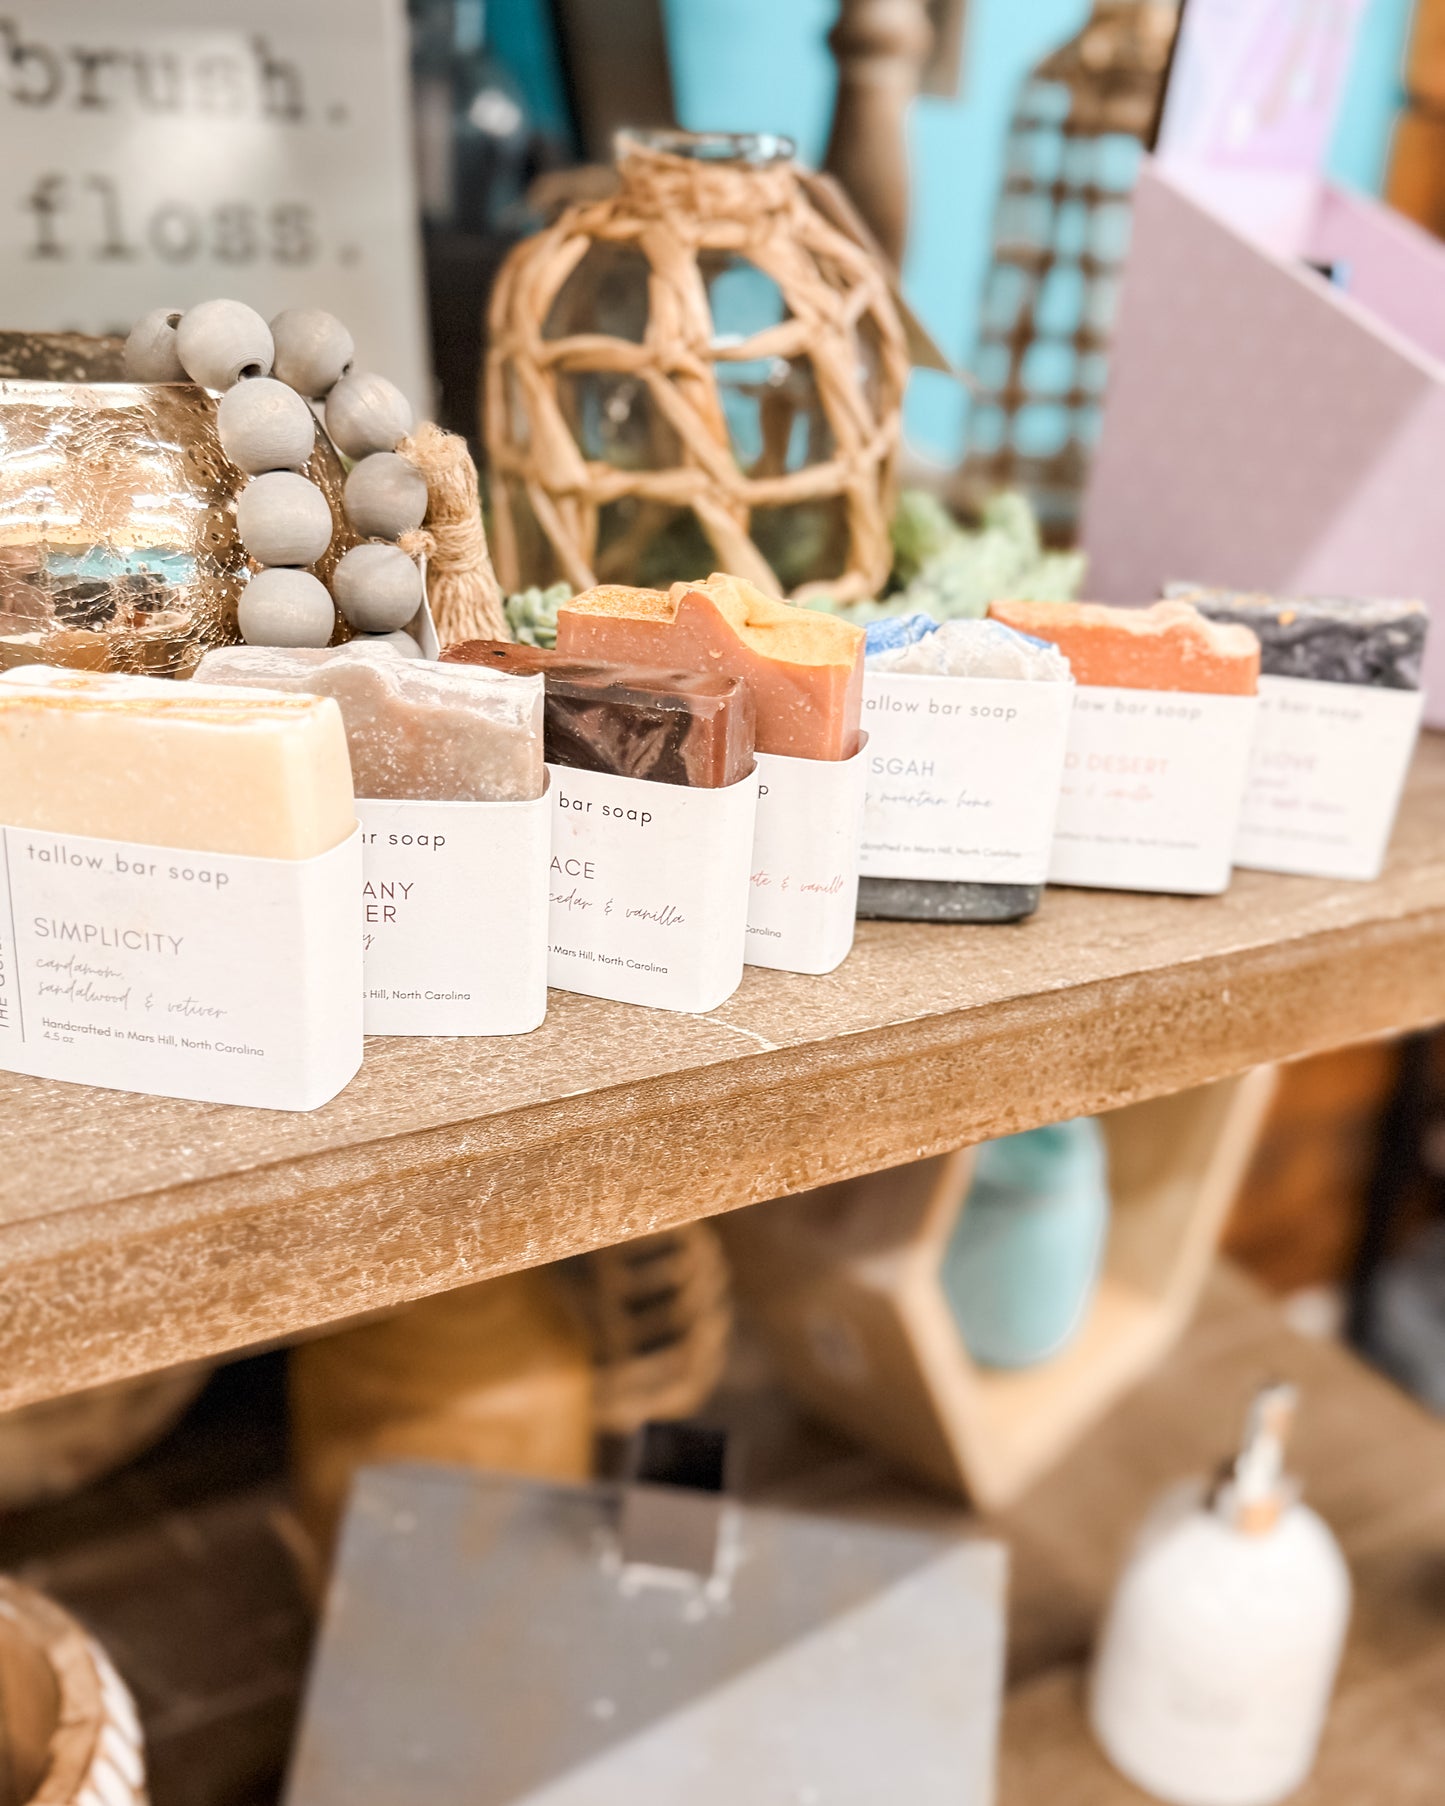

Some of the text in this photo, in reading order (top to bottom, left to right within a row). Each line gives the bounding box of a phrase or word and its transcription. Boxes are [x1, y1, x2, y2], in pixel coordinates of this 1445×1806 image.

[0, 15, 352, 126] brush.
[23, 173, 360, 266] floss.
[861, 694, 1018, 723] allow bar soap
[1114, 699, 1147, 715] bar
[1155, 705, 1203, 723] soap
[871, 757, 935, 777] SGAH
[1087, 752, 1169, 775] DESERT
[559, 791, 652, 827] bar soap
[388, 834, 446, 851] soap
[27, 844, 229, 890] tallow bar soap
[550, 856, 596, 880] ACE
[363, 881, 414, 900] ANY
[366, 904, 397, 923] ER
[604, 898, 614, 916] &
[626, 905, 686, 926] vanilla
[34, 917, 184, 955] SIMPLICITY
[553, 945, 577, 957] Mars
[578, 950, 596, 962] Hill,
[598, 954, 624, 967] North
[626, 959, 668, 974] Carolina
[38, 979, 228, 1019] sandalwood & vetiver
[370, 990, 389, 1000] Hill,
[392, 990, 421, 1000] North
[424, 990, 471, 1000] Carolina
[42, 1017, 265, 1057] Handcrafted in Mars Hill, North Carolina
[62, 1035, 75, 1044] oz
